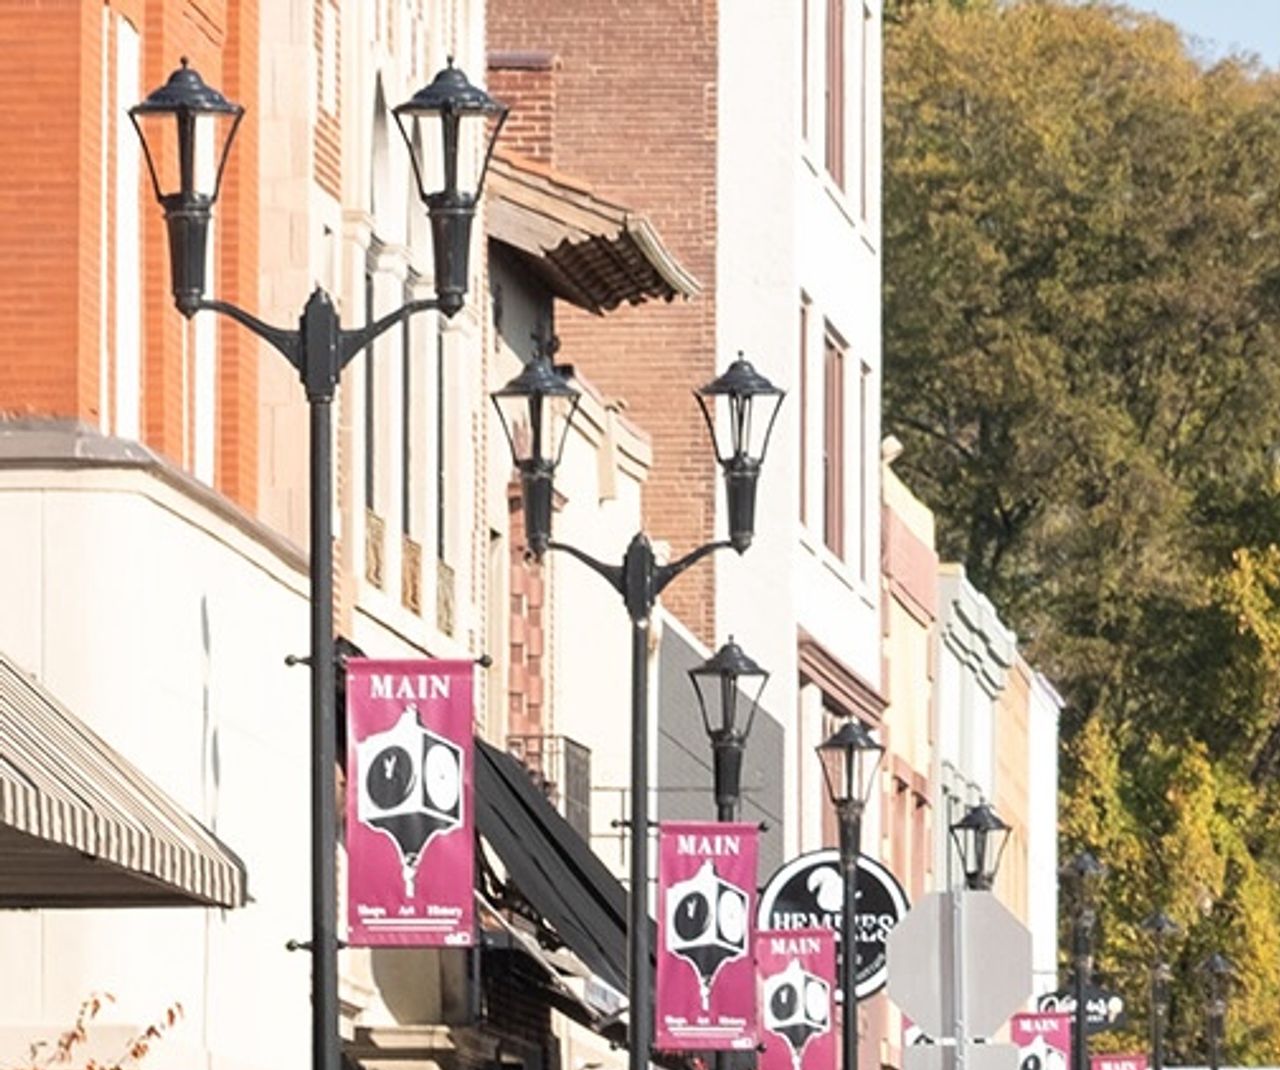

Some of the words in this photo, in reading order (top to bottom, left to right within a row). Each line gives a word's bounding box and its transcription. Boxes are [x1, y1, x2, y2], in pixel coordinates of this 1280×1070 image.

[370, 674, 451, 699] MAIN
[677, 835, 742, 856] MAIN
[770, 937, 822, 955] MAIN
[1019, 1019, 1060, 1032] MAIN
